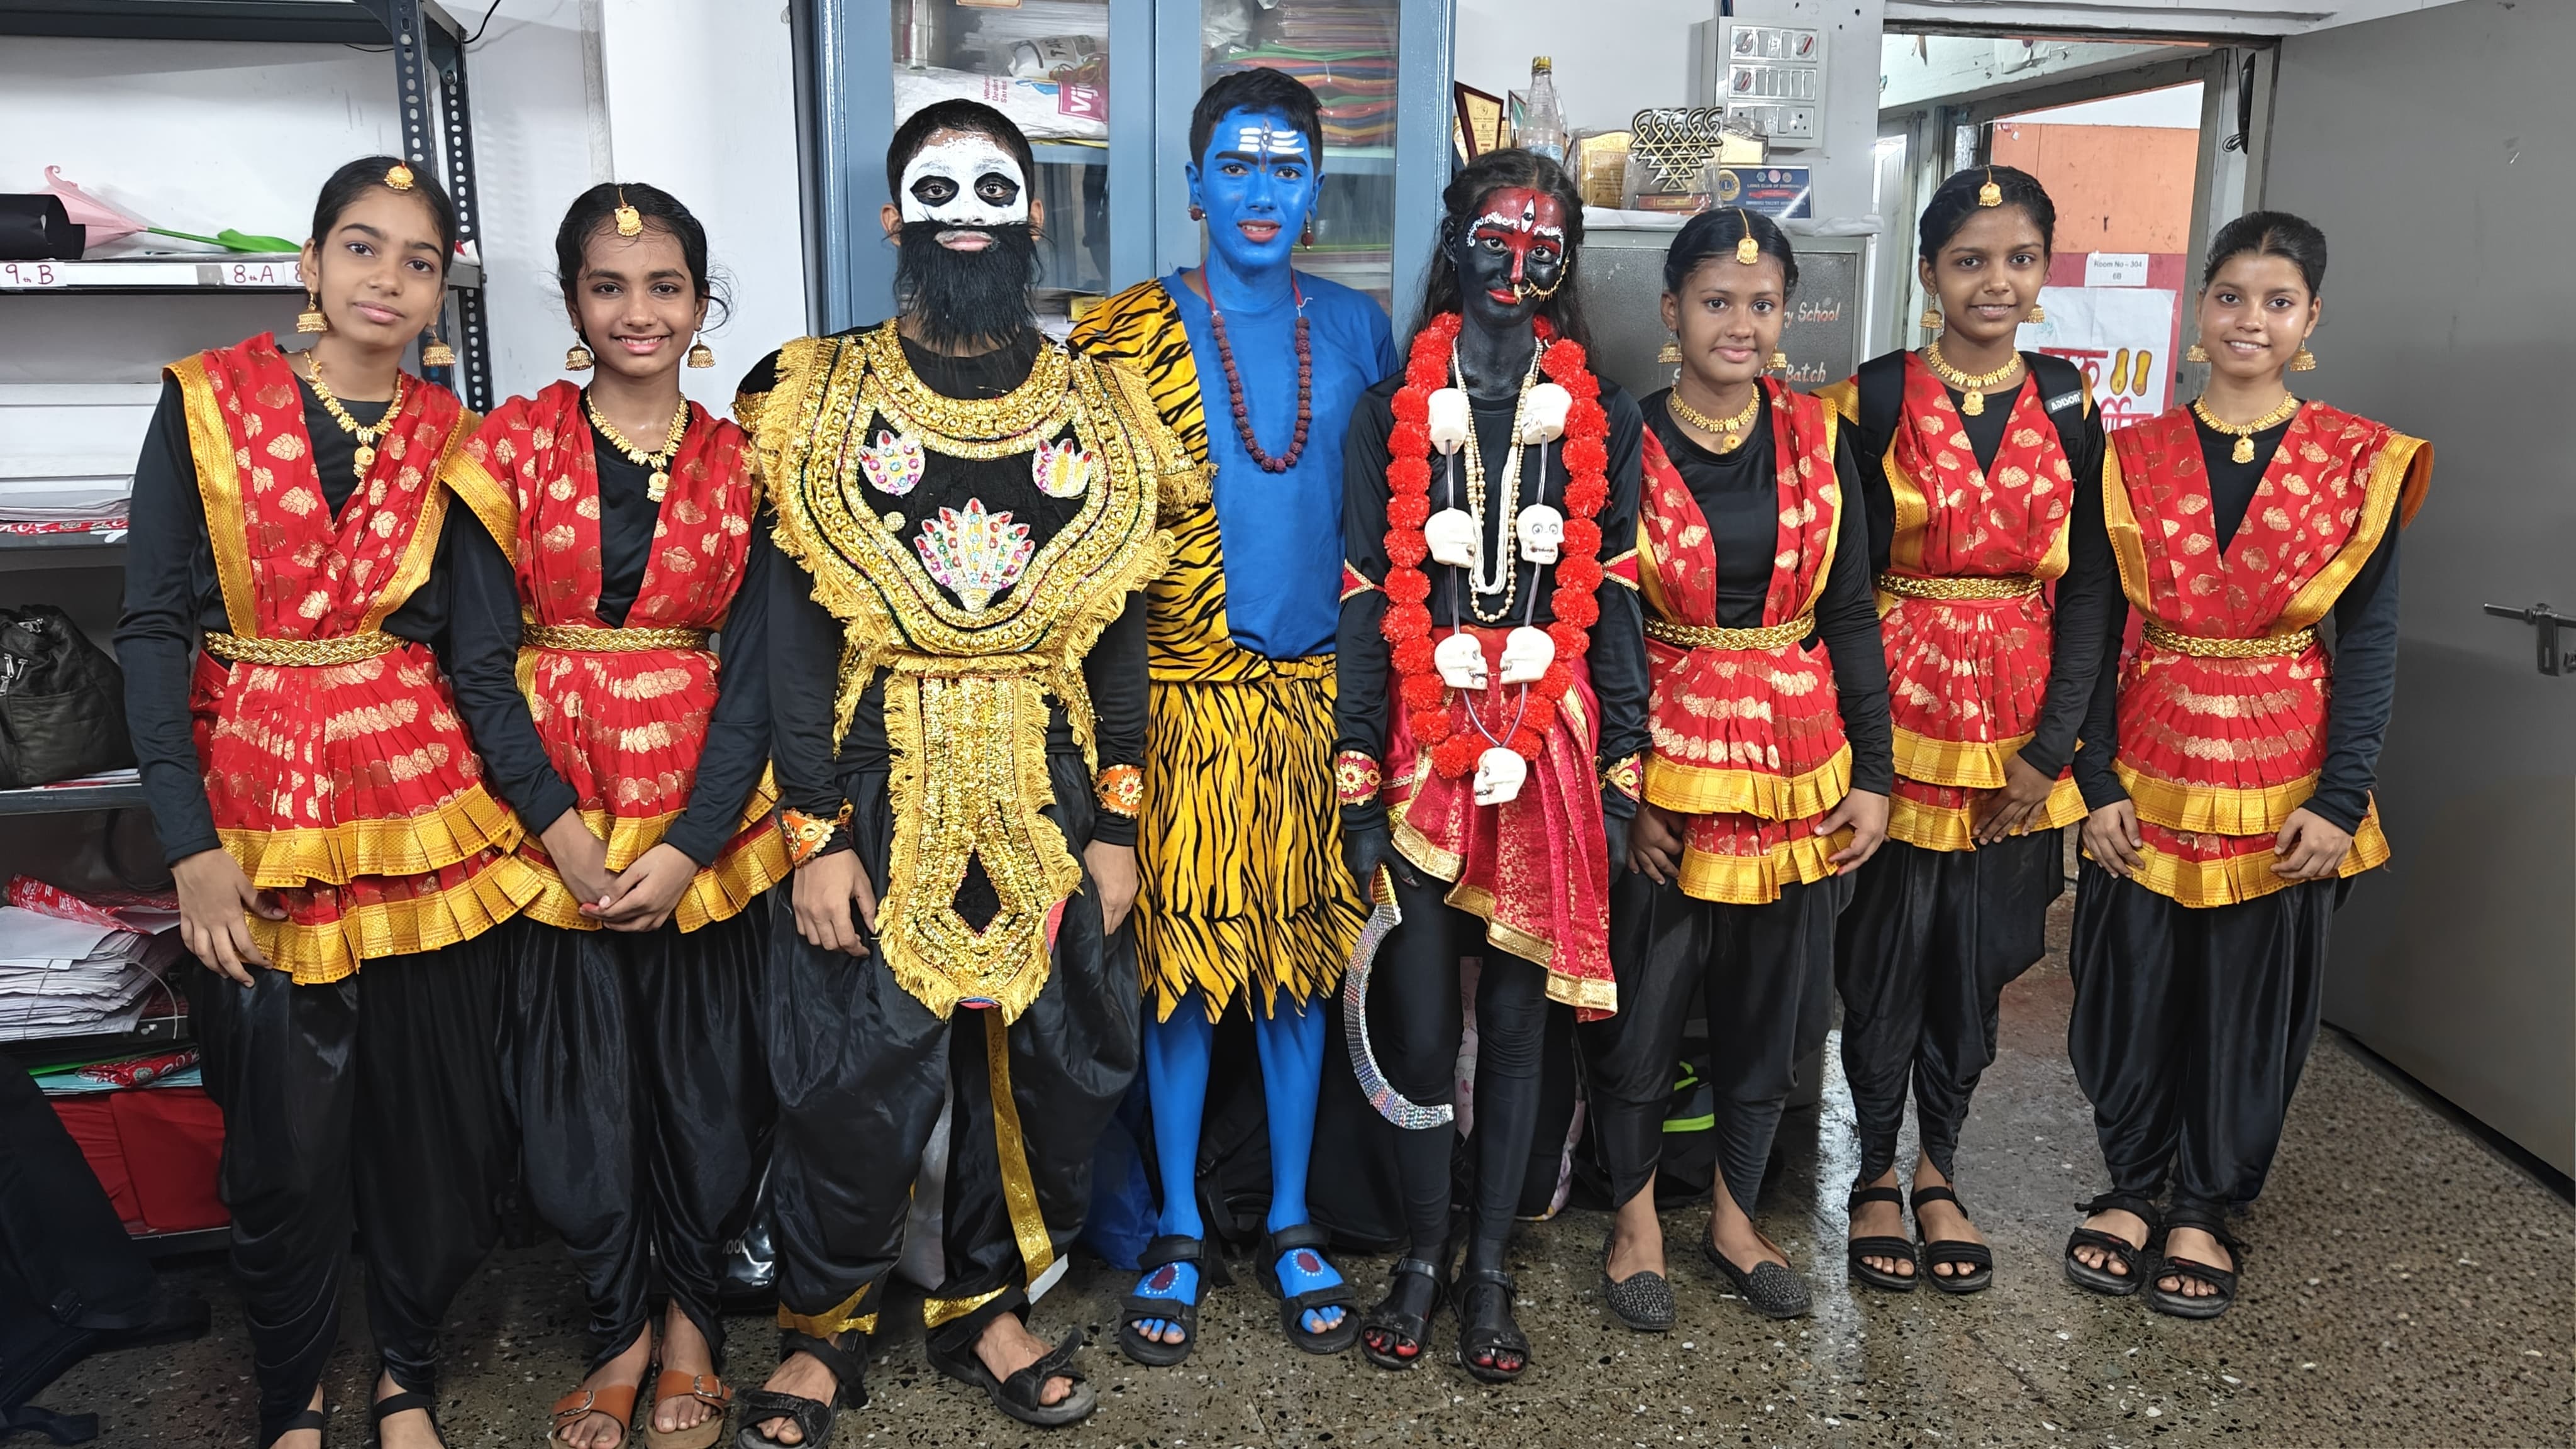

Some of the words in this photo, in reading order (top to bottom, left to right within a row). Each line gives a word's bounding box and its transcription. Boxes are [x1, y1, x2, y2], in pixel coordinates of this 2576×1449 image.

[37, 264, 54, 285] B
[260, 265, 274, 283] A
[1798, 301, 1841, 323] School
[1785, 362, 1827, 383] Batch
